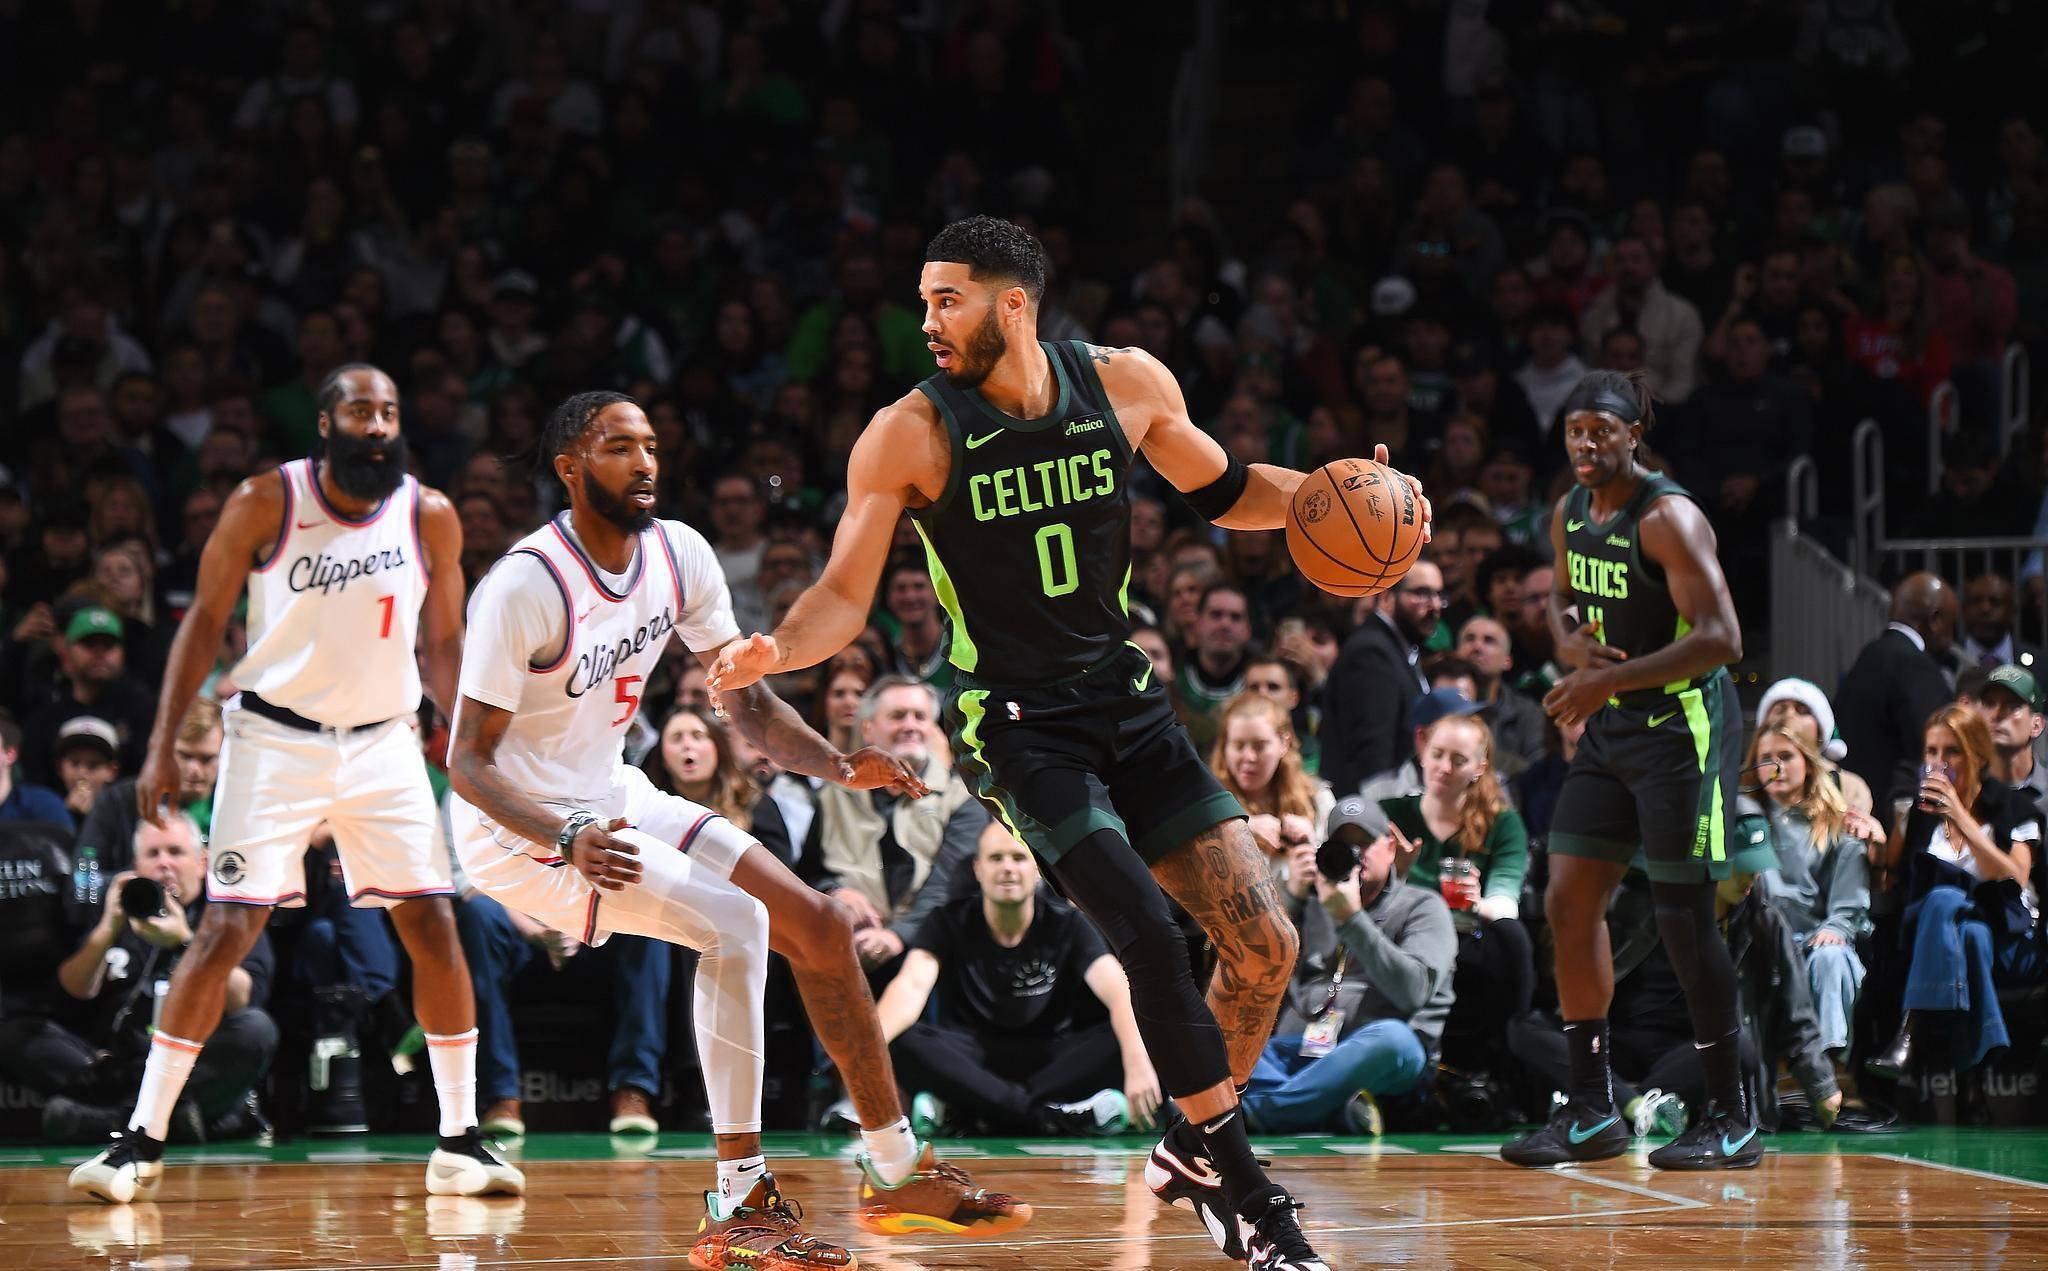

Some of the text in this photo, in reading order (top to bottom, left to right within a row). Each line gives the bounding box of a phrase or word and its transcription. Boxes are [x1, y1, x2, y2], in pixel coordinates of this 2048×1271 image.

[1065, 419, 1105, 436] Amica
[969, 448, 1115, 522] CELTICS
[289, 546, 405, 596] Clippers
[1034, 522, 1080, 598] 0
[376, 595, 396, 639] 1
[565, 606, 675, 698] Clippers
[611, 674, 642, 728] 5
[1692, 814, 1710, 858] BOSTON
[520, 1069, 601, 1103] Blue
[1920, 1063, 2038, 1103] jetlue
